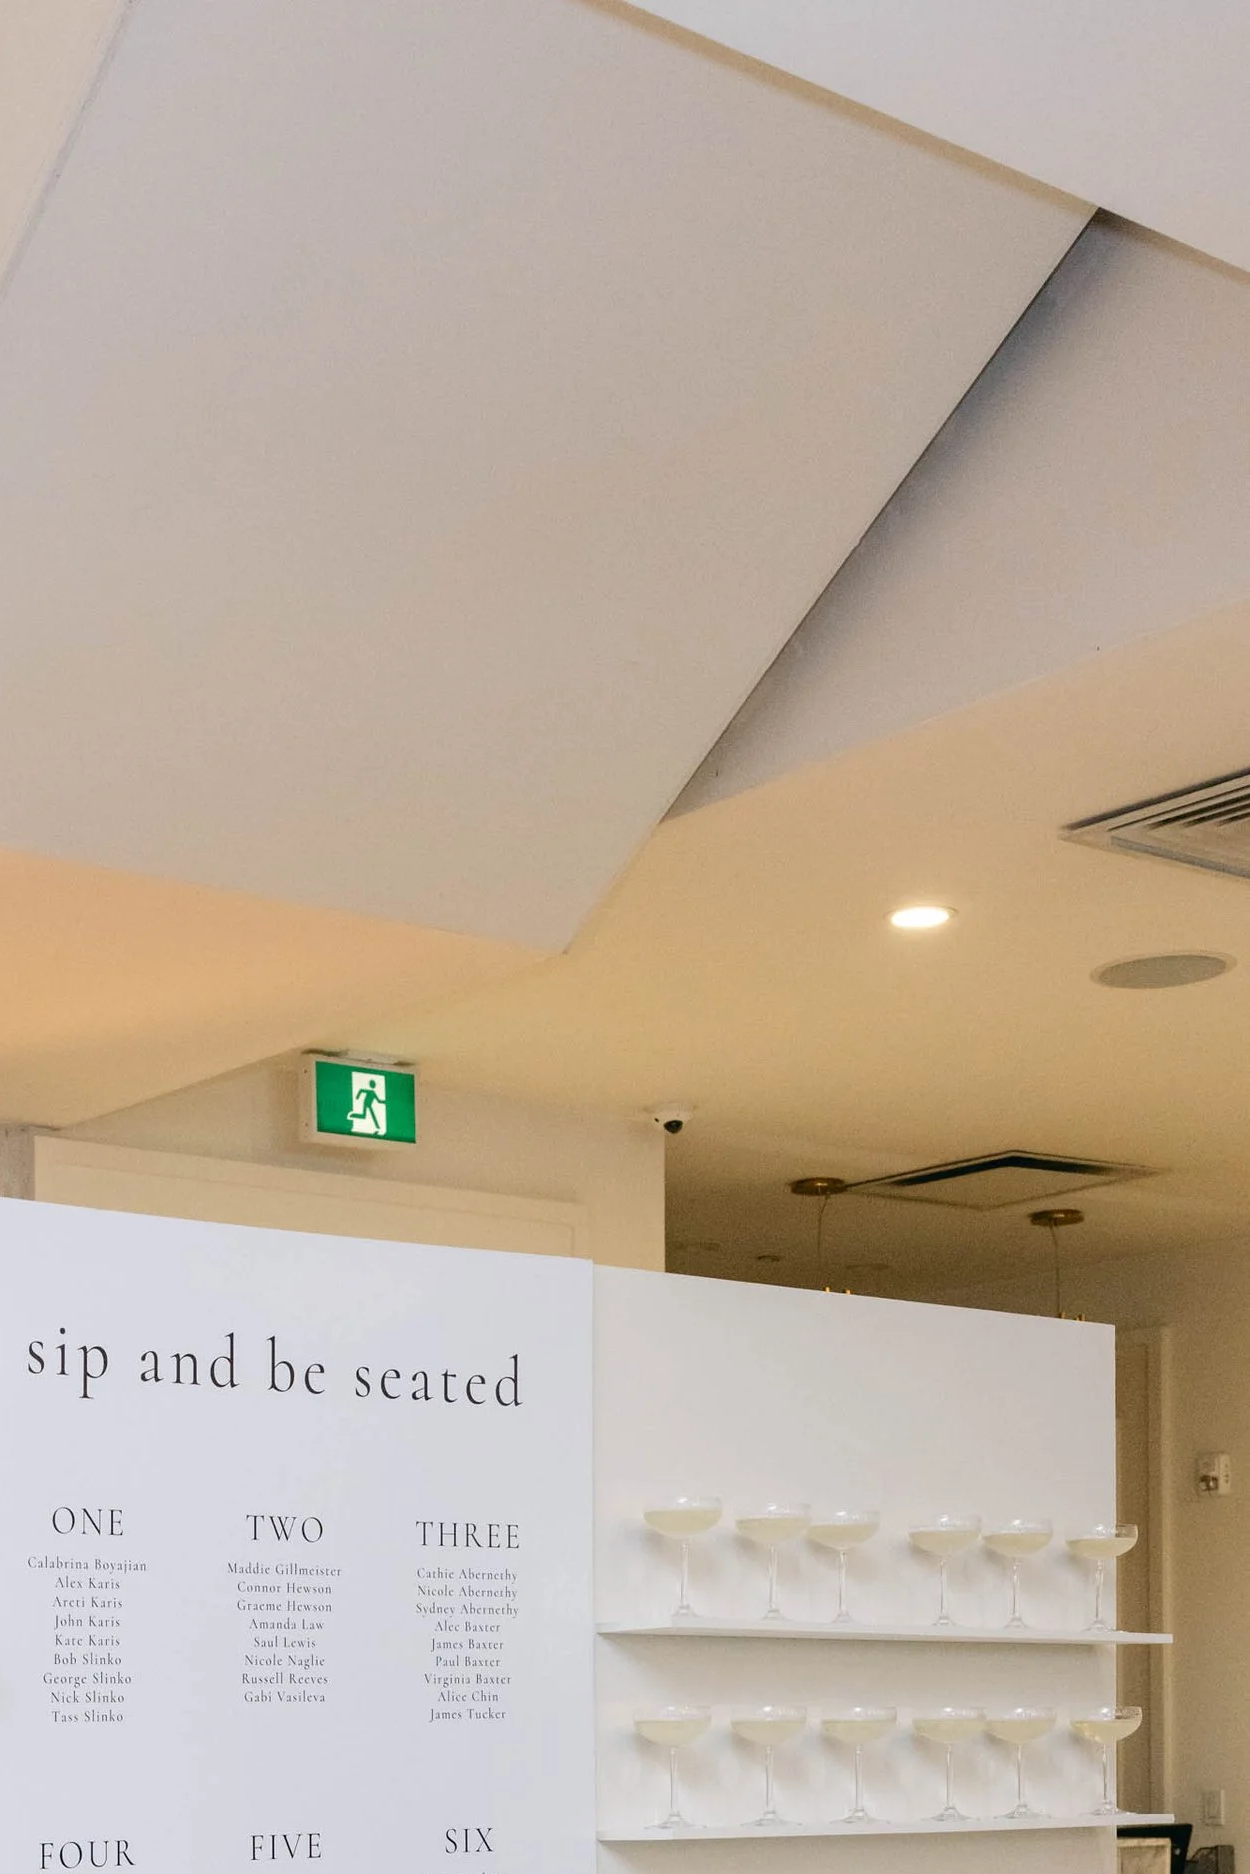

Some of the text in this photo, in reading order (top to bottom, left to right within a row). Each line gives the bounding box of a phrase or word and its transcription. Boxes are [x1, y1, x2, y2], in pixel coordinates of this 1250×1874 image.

[27, 1327, 523, 1407] sip and be seated
[52, 1506, 124, 1536] ONE
[246, 1514, 323, 1543] TWO
[415, 1521, 520, 1549] THREE
[27, 1555, 147, 1575] Calabrina Boyajian
[227, 1562, 342, 1576] Maddie Gillmeister
[55, 1575, 120, 1589] Alex Karis
[417, 1567, 518, 1584] Cathie Abernethy
[237, 1581, 332, 1594] Connor Hewson
[418, 1584, 518, 1601] Nicole Abernethy
[91, 1596, 123, 1608] Karis
[237, 1599, 332, 1612] Graeme Hewson
[416, 1602, 519, 1619] Sydney Abernethy
[54, 1613, 120, 1630] John Karis
[249, 1617, 324, 1630] Amanda Law
[465, 1621, 500, 1632] Baxter
[55, 1634, 120, 1647] Kate Karis
[254, 1635, 316, 1648] Saul Lewis
[430, 1638, 504, 1653] James Baxter
[54, 1652, 122, 1665] Bob Slinko
[245, 1653, 325, 1670] Nicole Naglie
[436, 1654, 500, 1667] Paul Baxter
[43, 1671, 132, 1689] George Slinko
[242, 1671, 328, 1684] Russell Reeves
[424, 1673, 511, 1688] Virginia Baxter
[51, 1690, 125, 1703] Nick Slinko
[244, 1689, 325, 1702] Gabi Vasileva
[438, 1690, 499, 1702] Alice Chin
[51, 1709, 123, 1723] Tass Slinko
[429, 1707, 506, 1723] James Tucker
[250, 1833, 322, 1861] FIVE
[445, 1827, 494, 1854] SIX
[39, 1839, 136, 1870] FOUR
